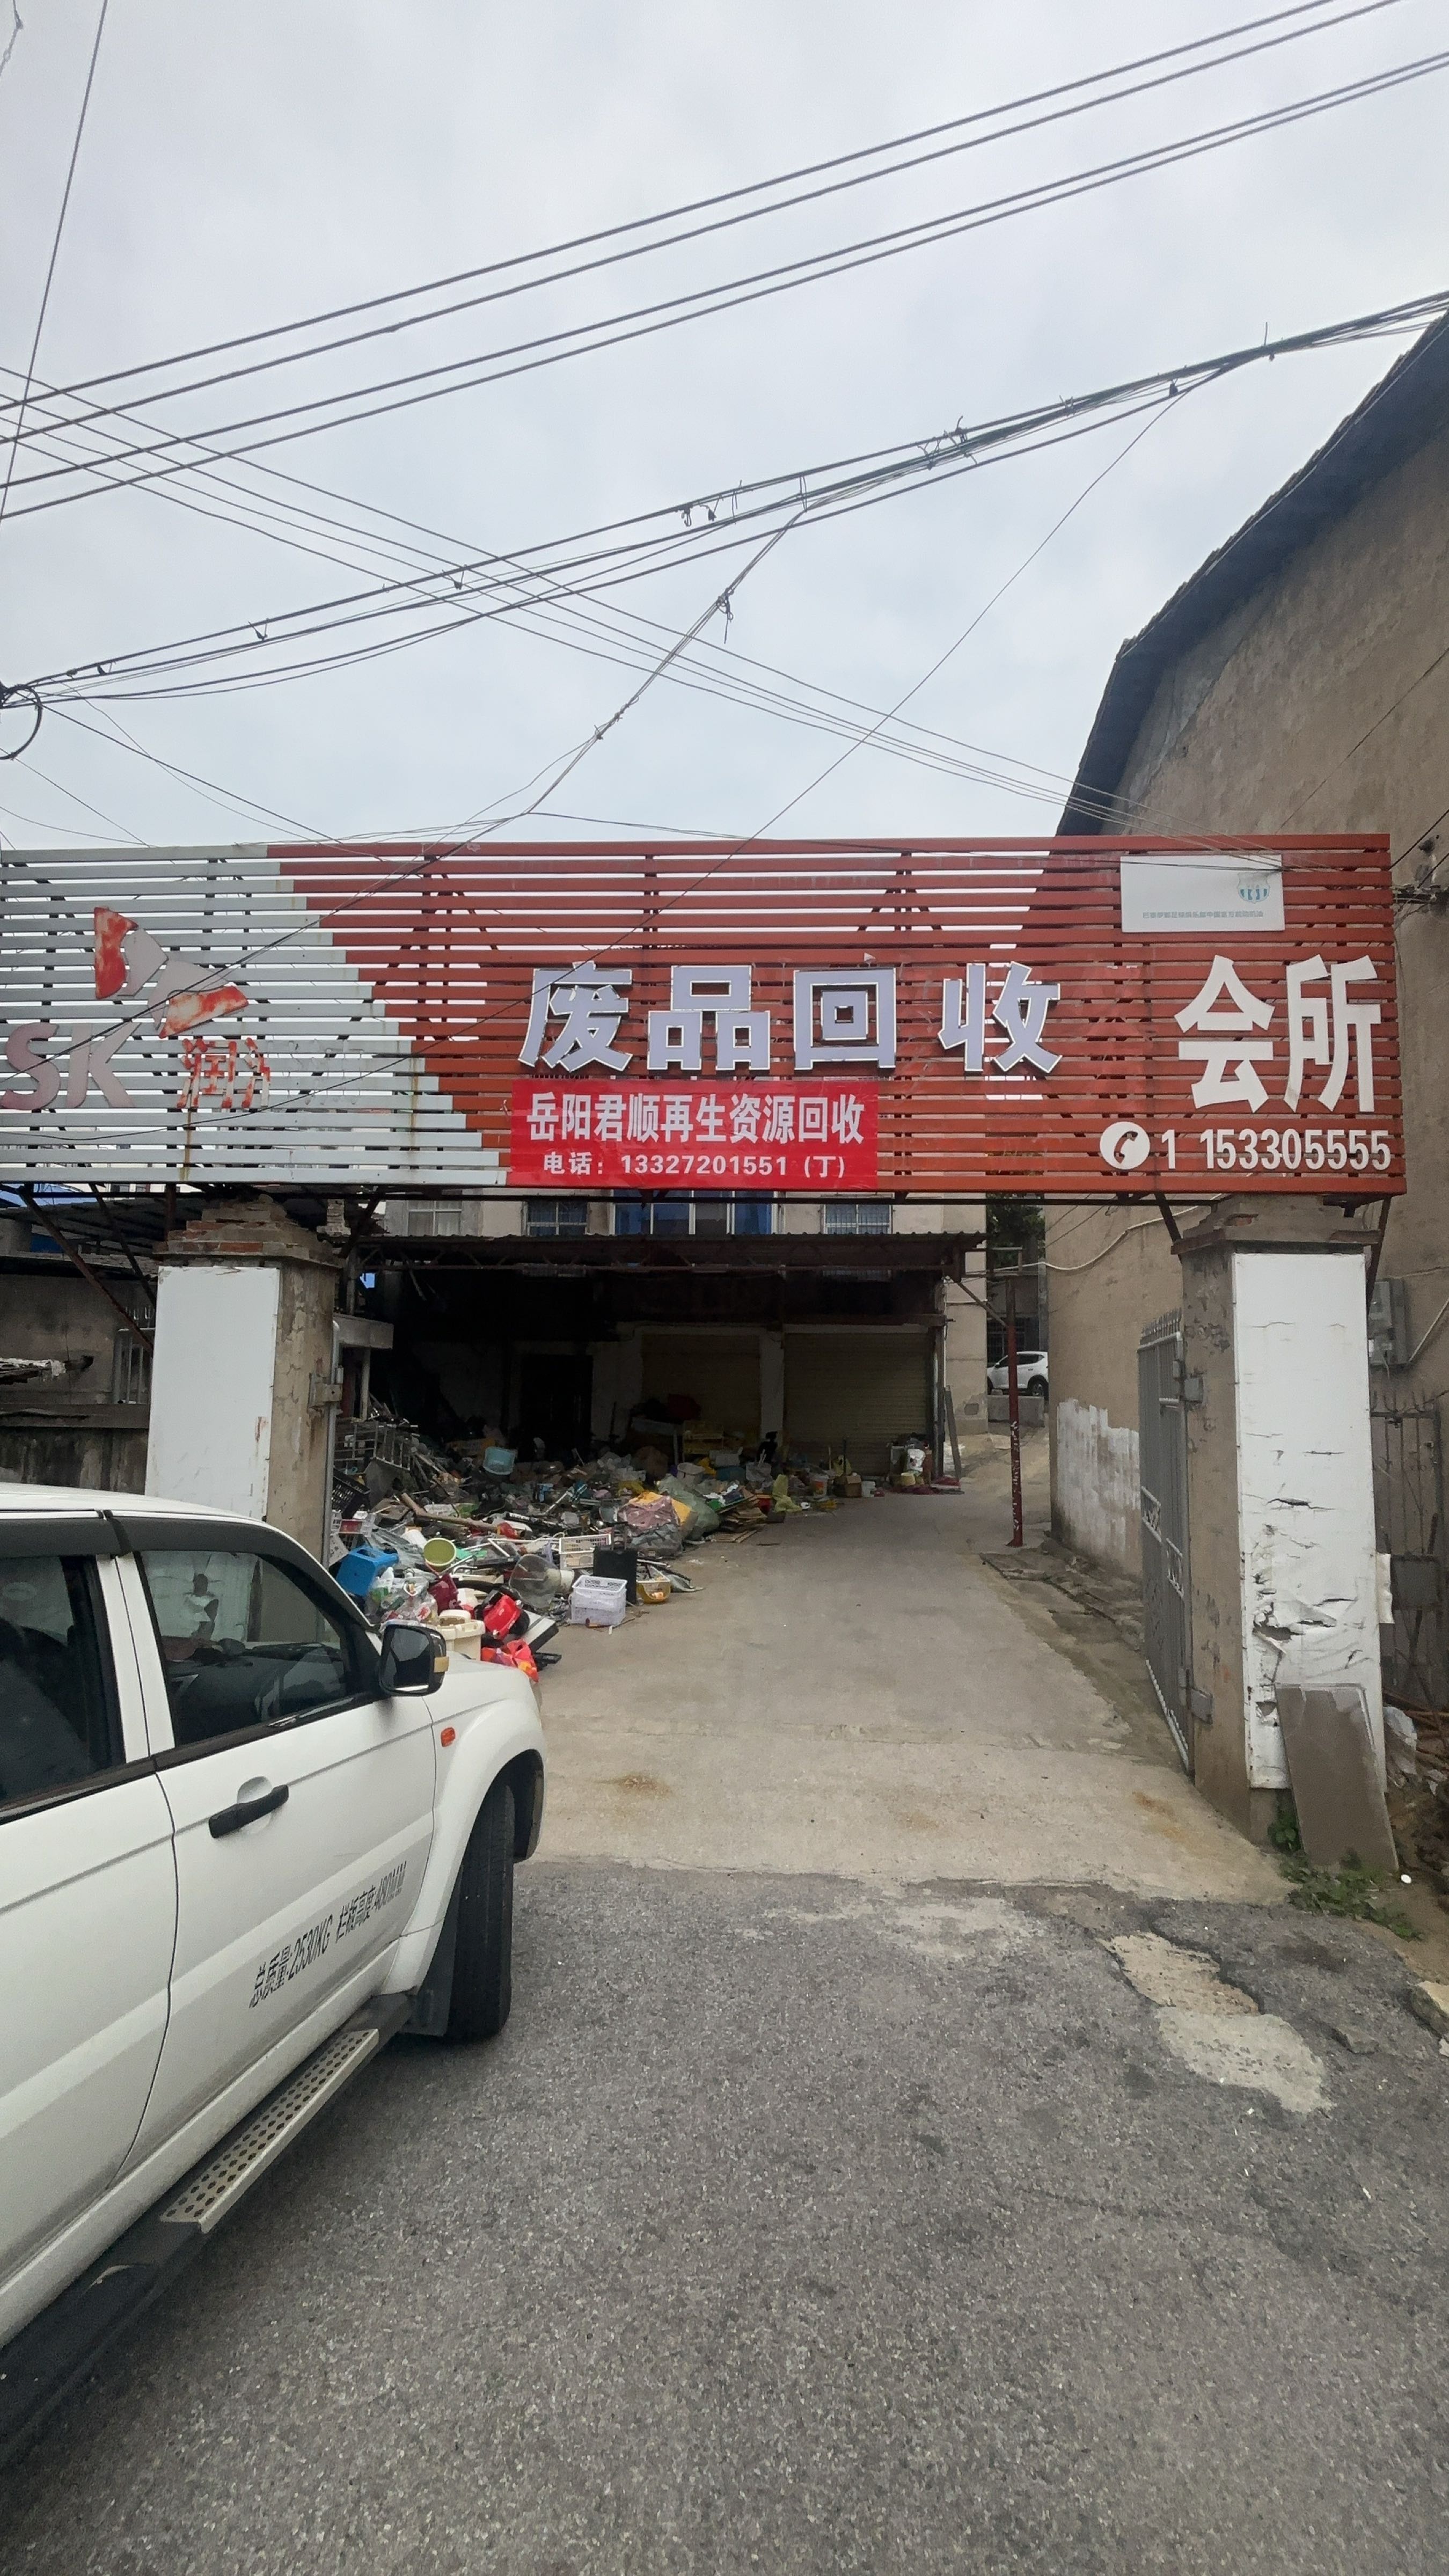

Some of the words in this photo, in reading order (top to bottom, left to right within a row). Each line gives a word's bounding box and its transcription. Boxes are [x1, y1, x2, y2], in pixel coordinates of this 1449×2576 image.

[517, 960, 1063, 1073] 废品回收
[1174, 954, 1381, 1114] 会所
[0, 1021, 142, 1111] SK
[526, 1092, 865, 1144] 岳阳君顺再生资源回收
[1161, 1129, 1176, 1169] 1
[1199, 1128, 1391, 1170] 153305555
[621, 1154, 787, 1176] 13327201551
